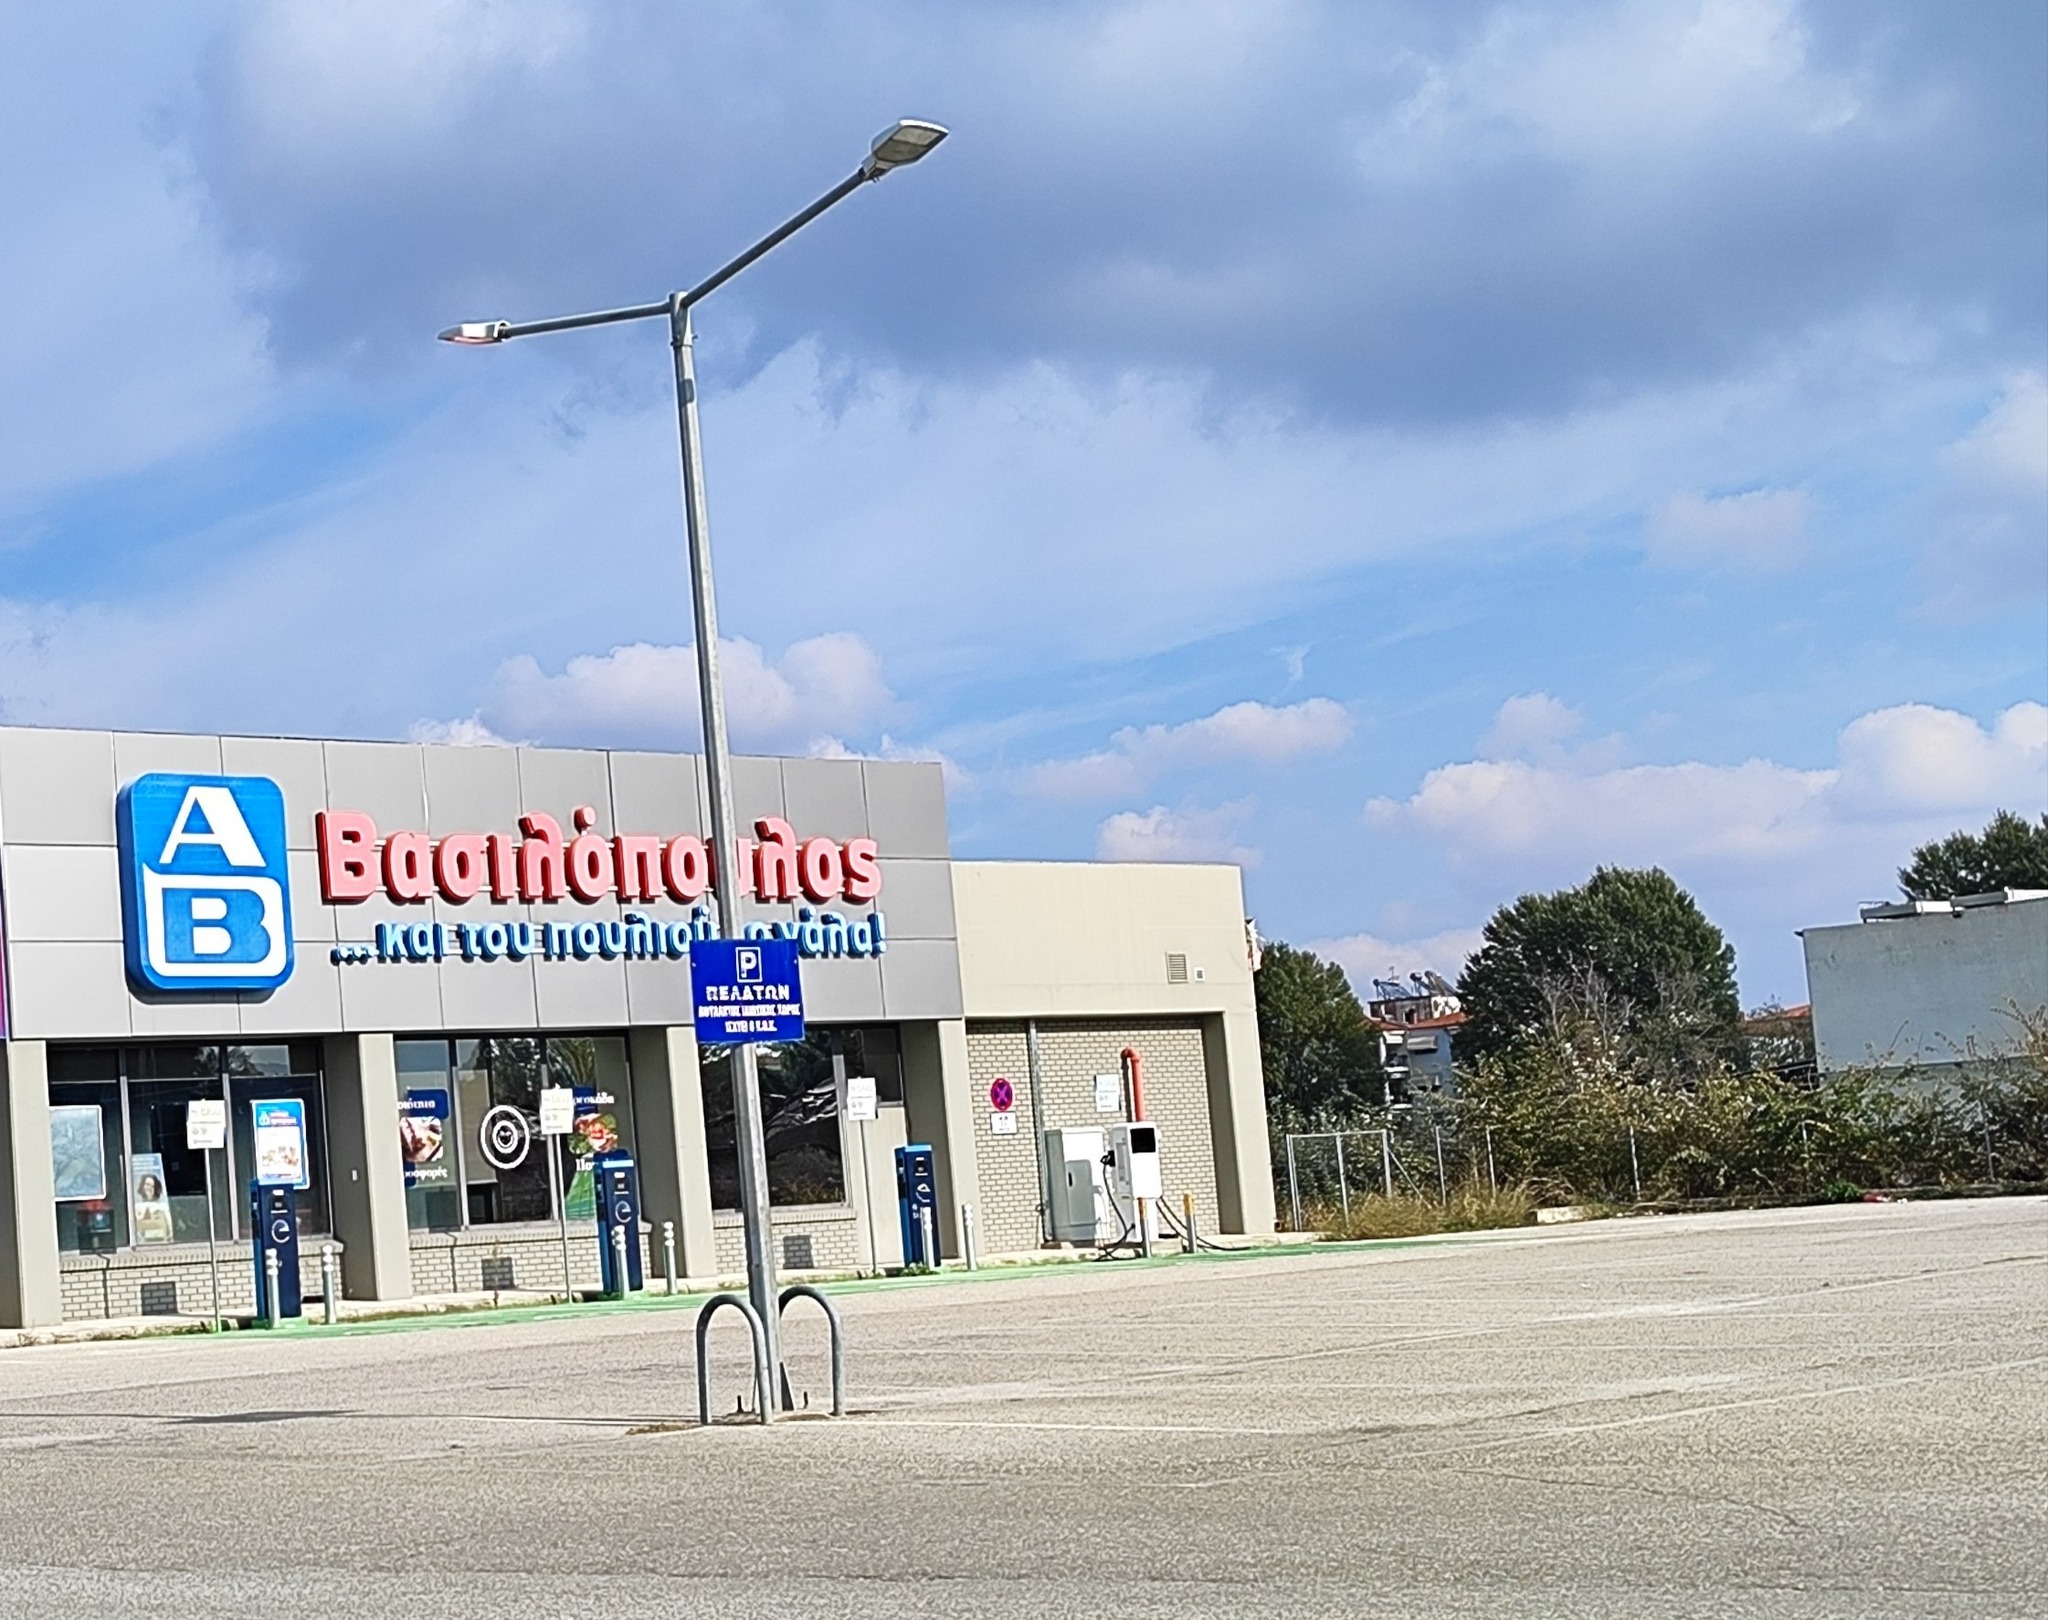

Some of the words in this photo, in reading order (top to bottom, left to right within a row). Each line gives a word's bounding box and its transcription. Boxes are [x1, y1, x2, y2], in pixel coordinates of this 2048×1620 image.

[456, 922, 537, 961] του
[740, 951, 757, 978] P
[706, 984, 790, 1001] ΠΕΛΑΤΩΝ
